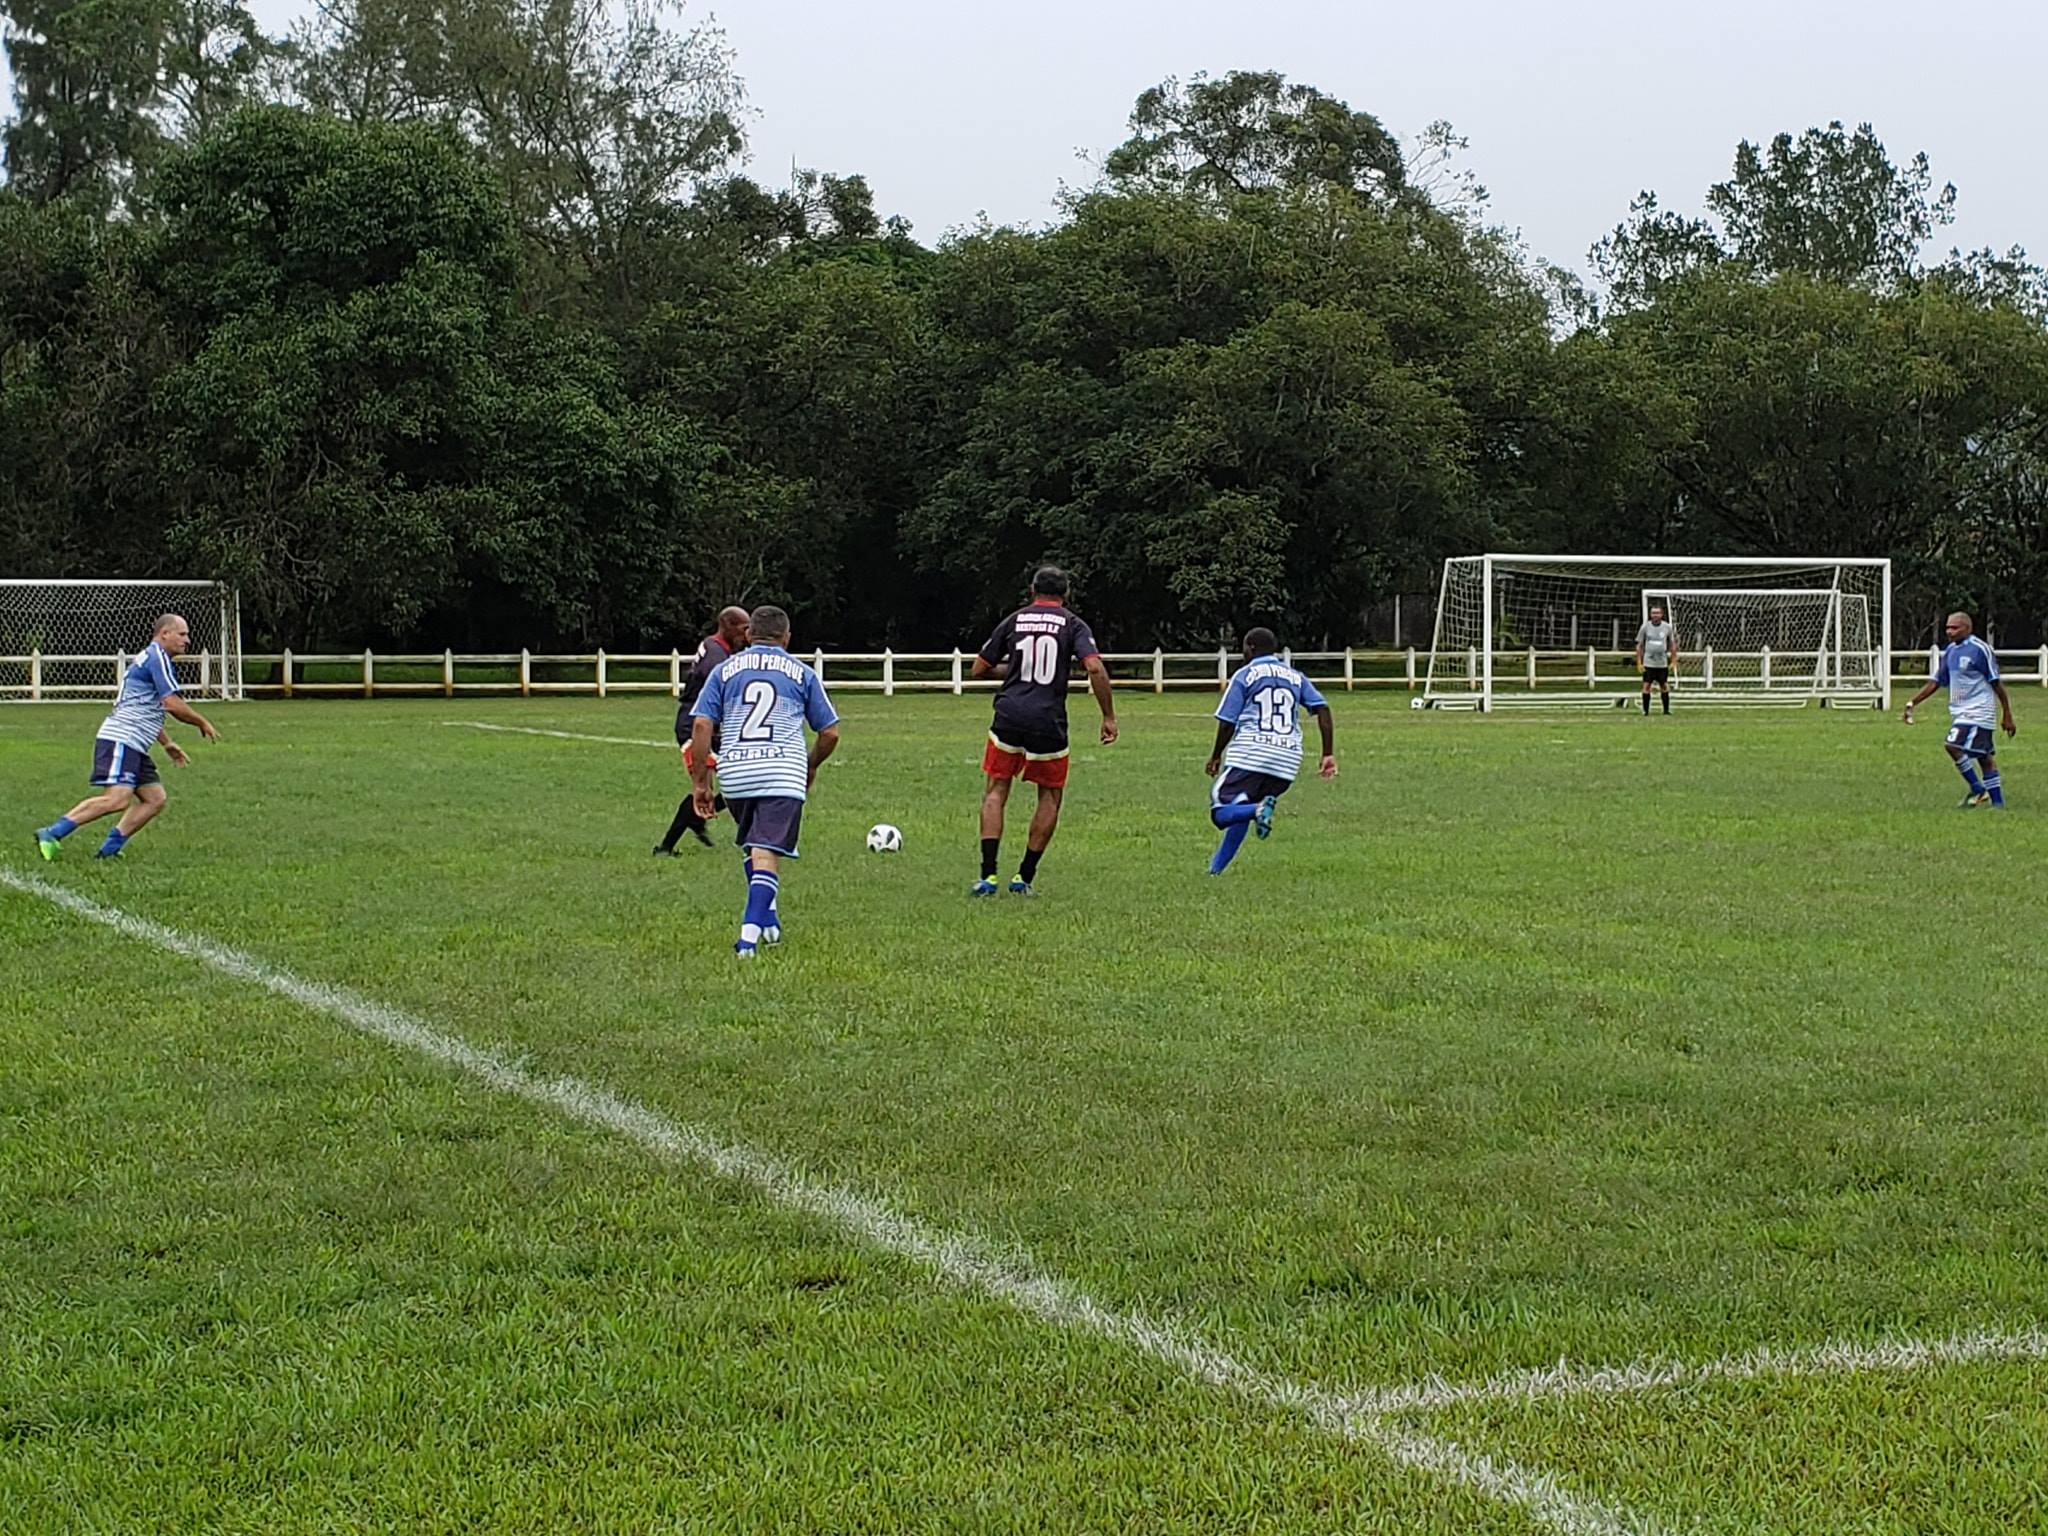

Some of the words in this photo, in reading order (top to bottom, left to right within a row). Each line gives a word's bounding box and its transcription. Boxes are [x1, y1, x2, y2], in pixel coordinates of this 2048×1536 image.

[1015, 634, 1058, 685] 10
[740, 680, 776, 741] 2
[1253, 686, 1295, 735] 13
